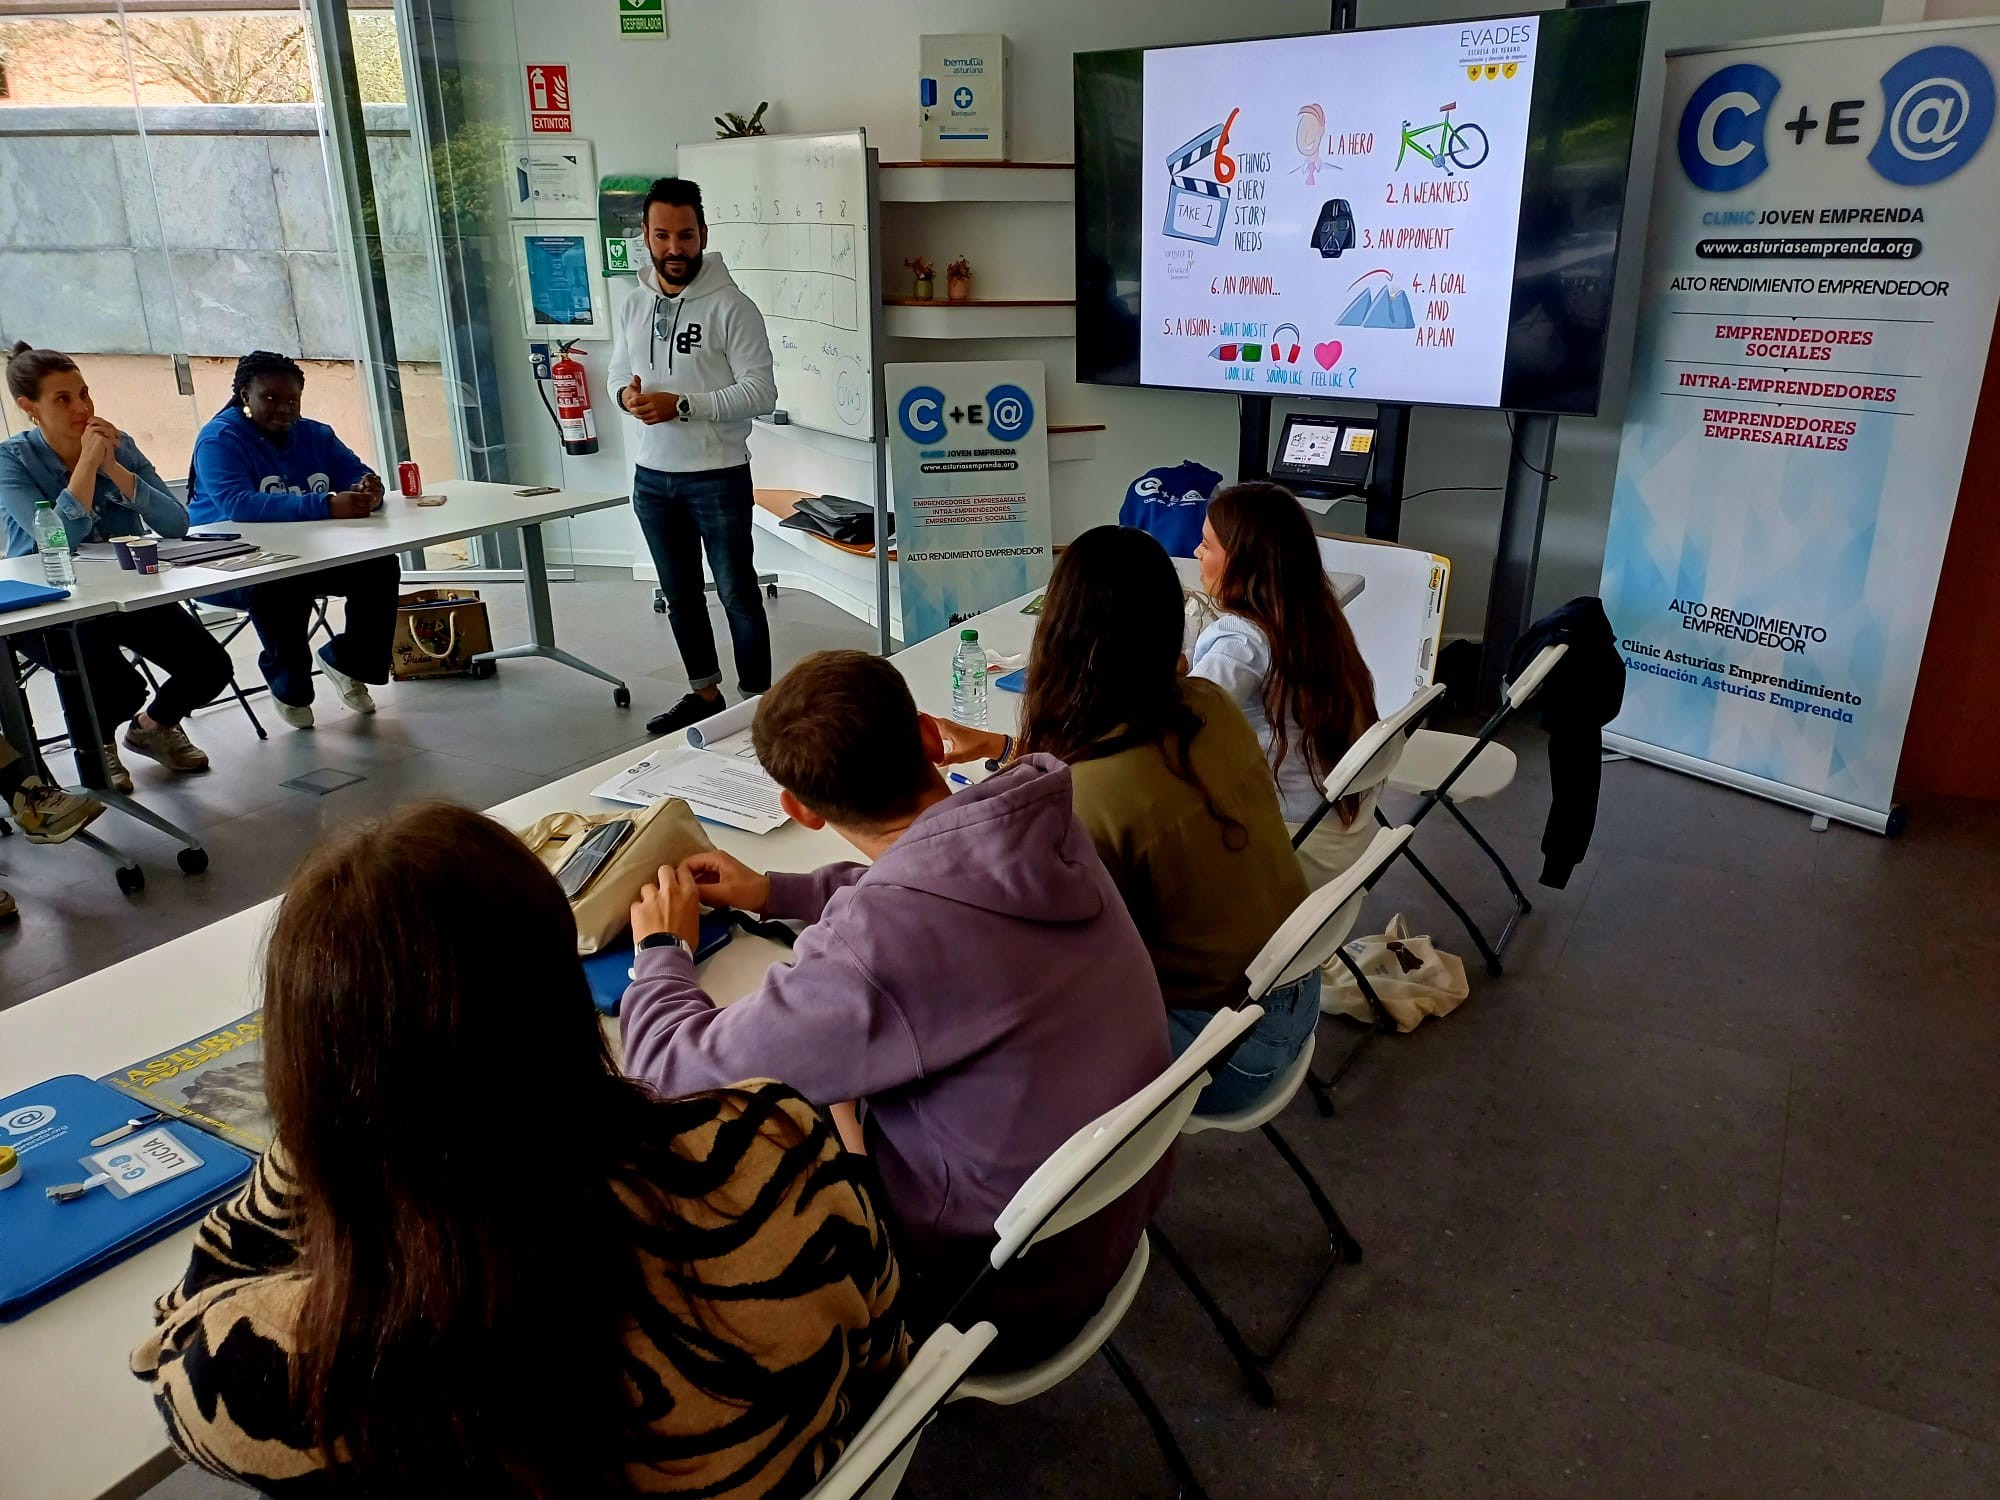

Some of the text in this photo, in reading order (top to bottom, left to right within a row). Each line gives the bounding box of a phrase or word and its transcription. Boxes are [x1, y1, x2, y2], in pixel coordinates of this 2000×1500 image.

[622, 16, 664, 31] DESFIBRILADOR
[1460, 25, 1531, 48] EVADES
[533, 116, 571, 131] EXTINTOR
[1214, 107, 1241, 184] 6
[1338, 134, 1346, 155] A
[1348, 132, 1374, 155] HERO
[1237, 152, 1272, 174] THINGS
[1236, 179, 1265, 200] EVERY
[1386, 181, 1470, 204] 2. A WEAKNESS
[840, 200, 846, 218] 8
[1178, 204, 1200, 220] TAKE
[1234, 206, 1266, 226] STORY
[1702, 207, 1925, 227] CLINIC JOVEN EMPRENDA
[1234, 232, 1262, 252] NEEDS
[1363, 228, 1454, 250] 3. AN OPPONENT
[1702, 236, 1914, 258] www.asturiasemprenda.org
[611, 258, 629, 269] DEA
[1210, 276, 1220, 294] 6.
[1222, 276, 1236, 295] AN
[1412, 273, 1466, 294] 4. A GOAL
[1670, 276, 1950, 298] ALTO RENDIMIENTO EMPRENDEDOR
[1426, 300, 1449, 322] AND
[1164, 318, 1174, 336] 5.
[1175, 318, 1184, 337] A
[1220, 321, 1269, 338] WHAT DOES IT
[1415, 326, 1455, 348] A PLAN
[1714, 325, 1874, 346] EMPRENDEDORES
[1744, 343, 1832, 361] SOCIALES
[1224, 366, 1255, 383] LOOK LIKE
[1266, 367, 1303, 386] SOUND LIKE
[1311, 370, 1327, 387] FEEL
[1328, 372, 1344, 388] LIKE
[1679, 373, 1897, 402] INTRA-EMPRENDEDORES
[1702, 408, 1856, 436] EMPRENDEDORES
[1704, 424, 1849, 452] EMPRESARIALES
[946, 450, 973, 458] JOVEN
[974, 448, 1017, 458] EMPRENDA
[923, 462, 1015, 472] www.asturiasemprenda.org
[913, 496, 1027, 508] EMPRENDEDORES EMPRESARIALES
[932, 505, 1012, 515] INTRA-EMPRENDEDORES
[925, 514, 1017, 525] EMPRENDEDORES SOCIALES
[906, 546, 1044, 562] ALTO RENDIMIENTO EMPRENDEDOR
[1668, 598, 1828, 643] ALTO RENDIMIENTO
[1682, 616, 1806, 655] EMPRENDEDOR
[1621, 638, 1862, 706] Clinic Asturias Emprendimiento
[1624, 656, 1854, 724] Asociación Asturias Emprenda
[142, 1137, 186, 1170] LUCÍA
